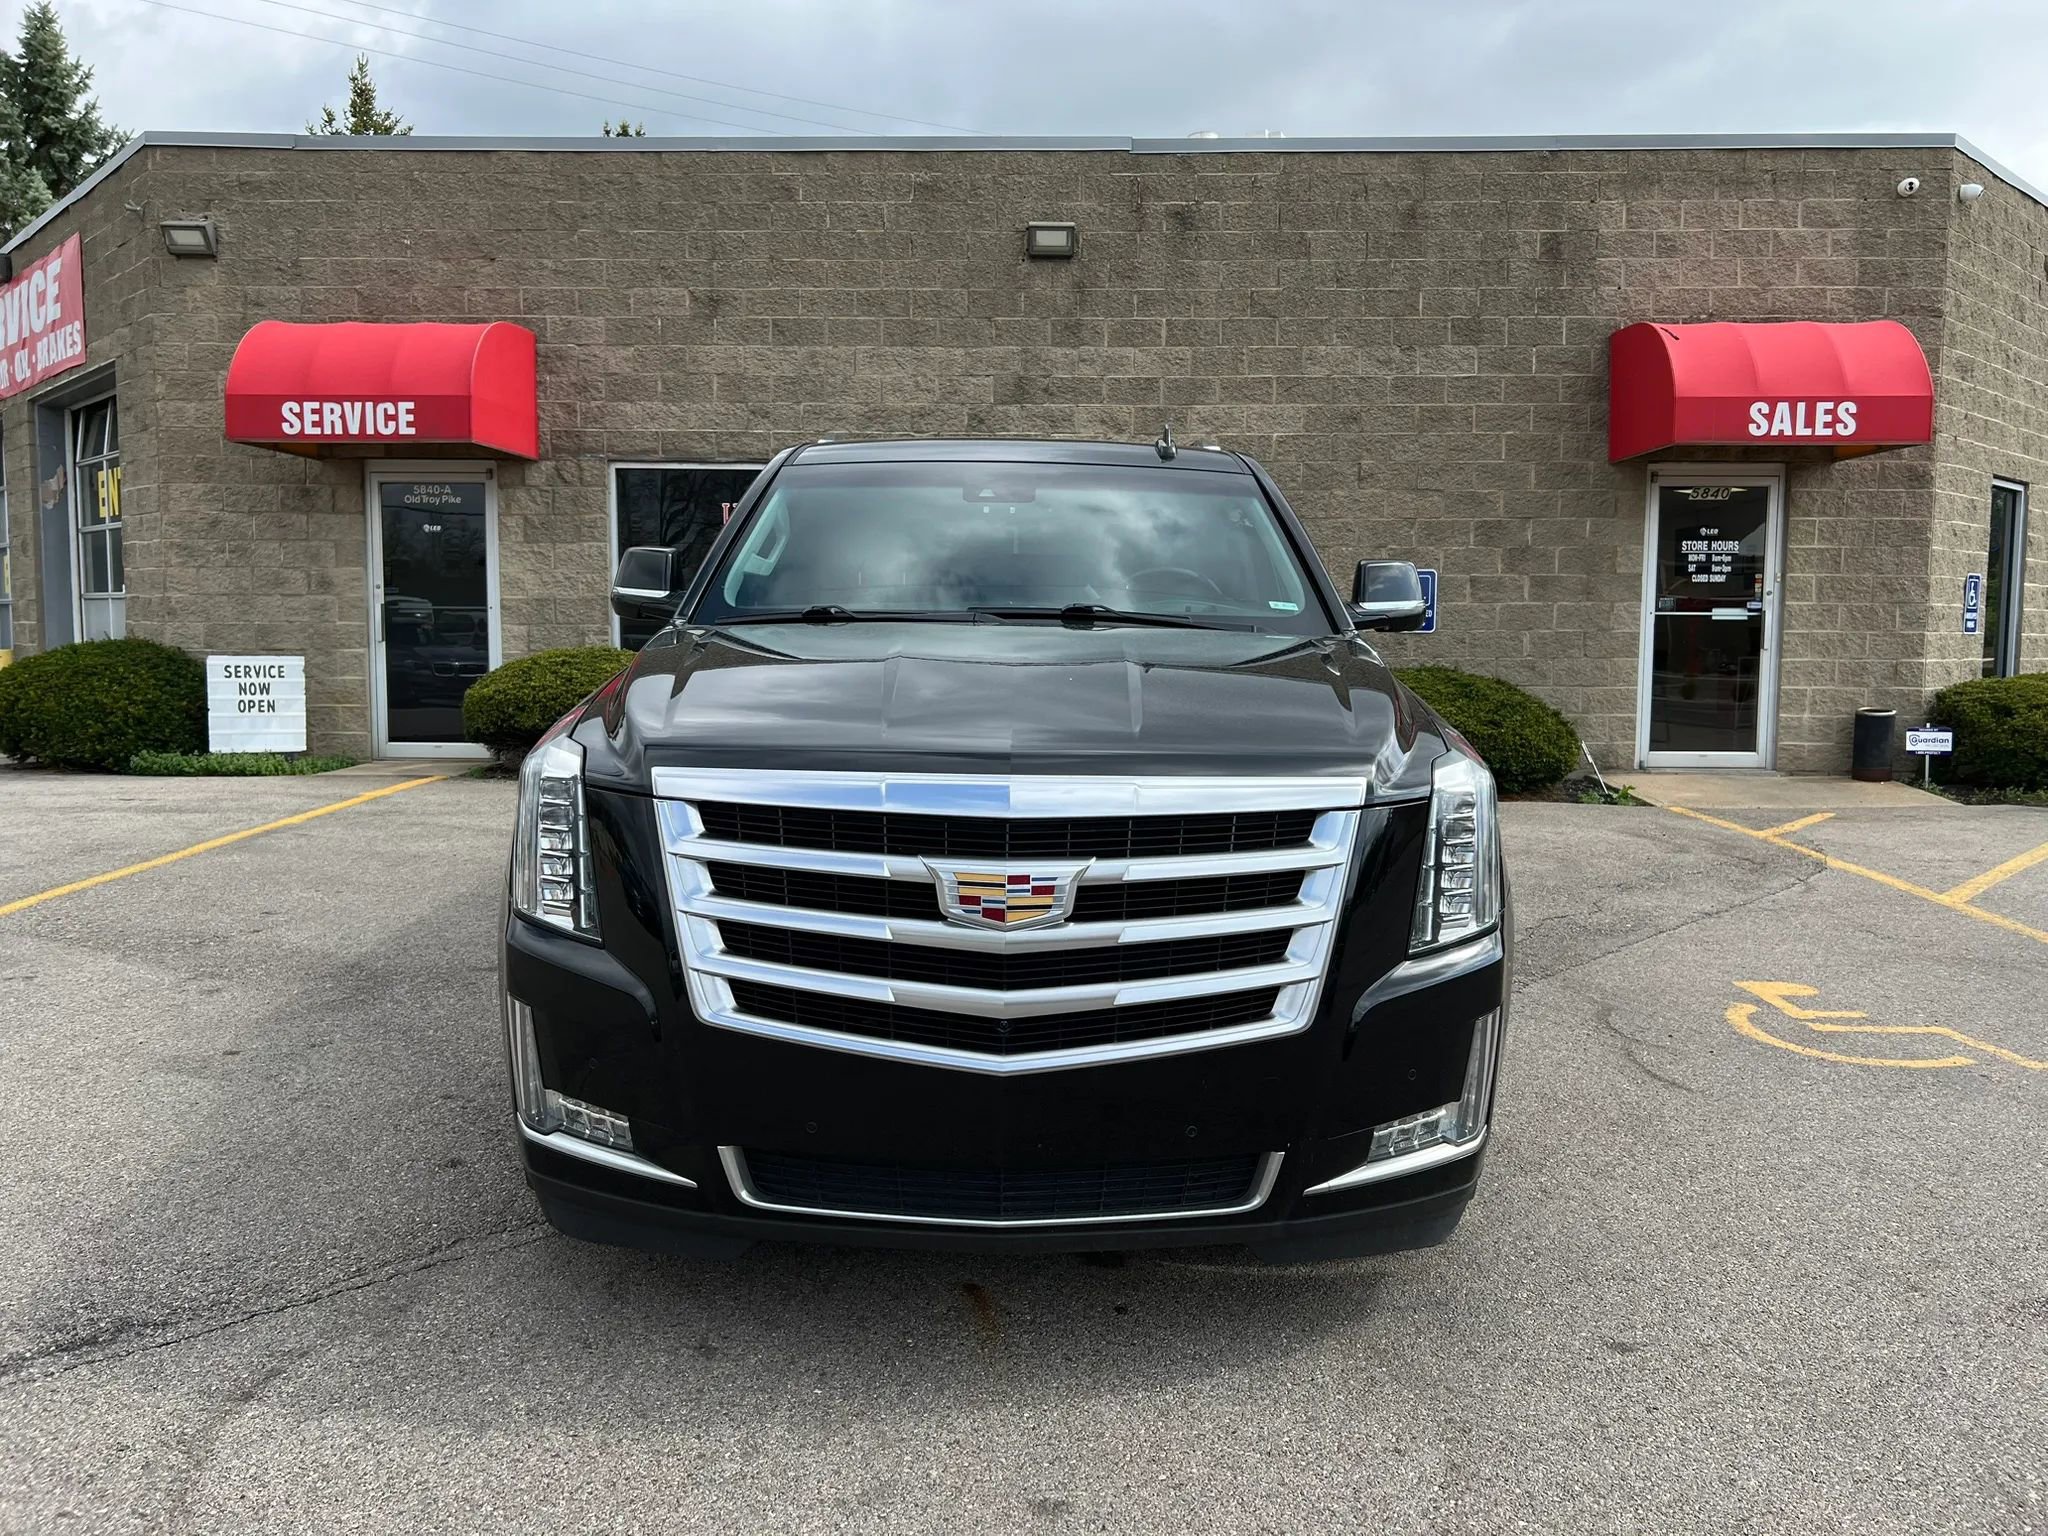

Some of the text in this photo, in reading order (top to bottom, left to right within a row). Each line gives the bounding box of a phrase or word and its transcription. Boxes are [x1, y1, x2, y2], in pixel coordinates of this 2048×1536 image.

[37, 320, 82, 371] BRAKES
[281, 401, 416, 435] SERVICE
[1748, 401, 1857, 436] SALES
[413, 485, 452, 494] 5840-A
[1691, 487, 1730, 499] 5840
[404, 495, 462, 505] Old Troy Pike
[1681, 540, 1739, 551] STORE HOURS
[1688, 564, 1696, 572] SAT
[1692, 574, 1726, 583] CLOSED SUNDAY
[224, 665, 285, 679] SERVICE
[238, 682, 271, 696] NOW
[237, 699, 276, 713] OPEN
[1909, 734, 1950, 746] Guardian
